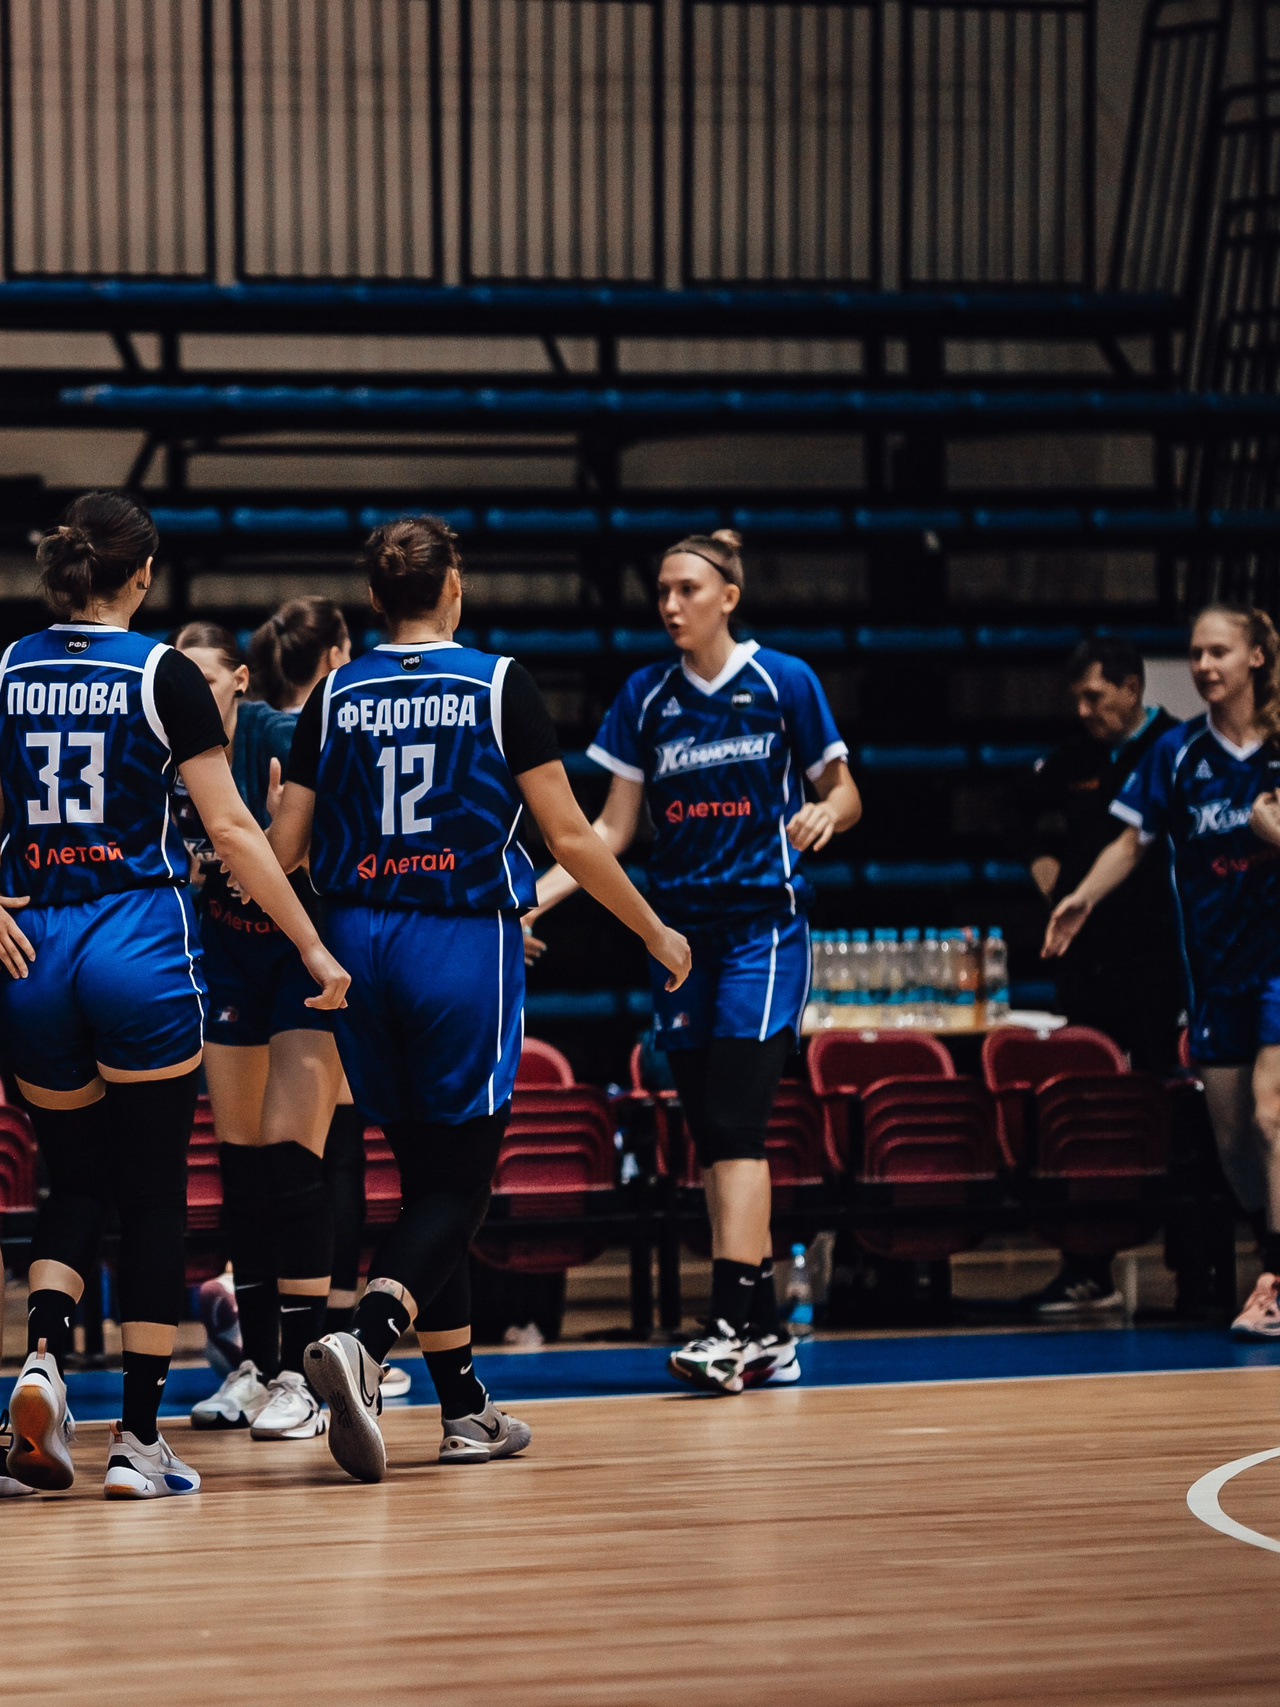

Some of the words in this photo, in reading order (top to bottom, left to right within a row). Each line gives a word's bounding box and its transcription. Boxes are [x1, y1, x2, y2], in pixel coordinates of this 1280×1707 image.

[7, 682, 128, 715] ПОПОВА
[337, 694, 477, 737] ФЕДОТОВА
[26, 732, 105, 825] 33
[376, 743, 436, 835] 12
[46, 842, 124, 866] летай
[383, 848, 455, 875] летай
